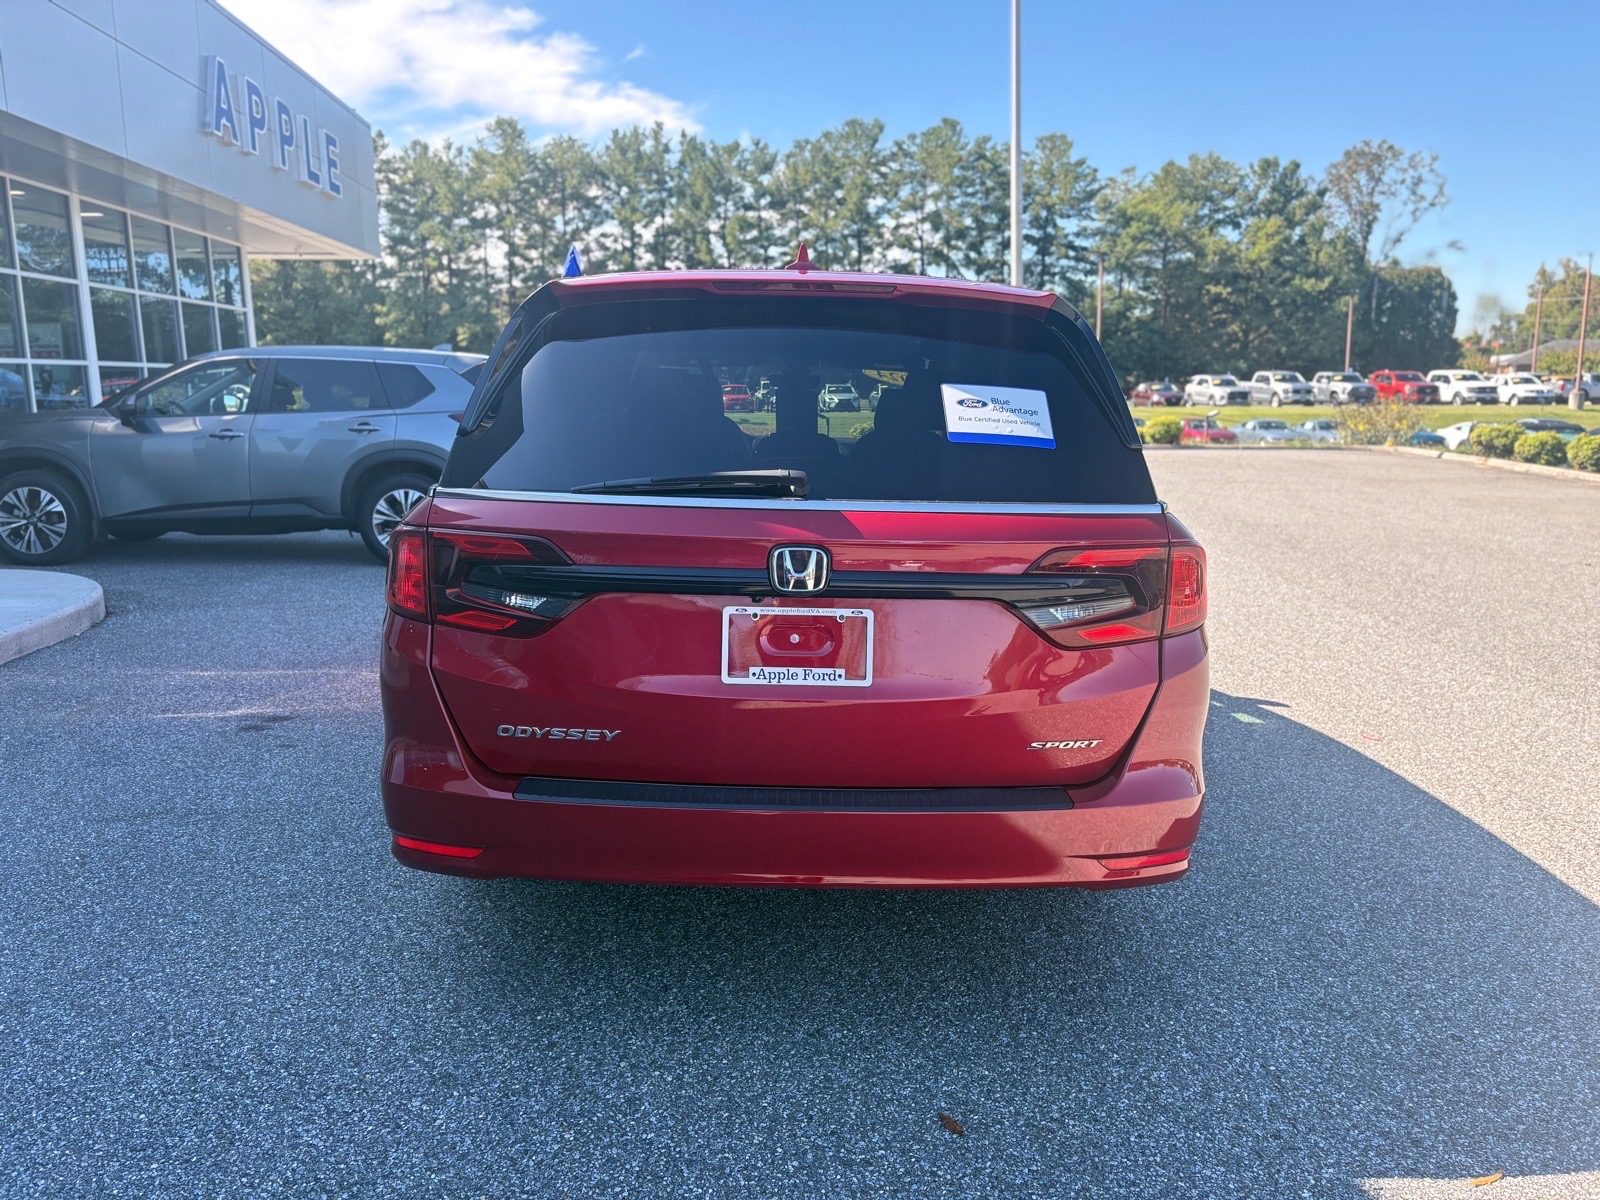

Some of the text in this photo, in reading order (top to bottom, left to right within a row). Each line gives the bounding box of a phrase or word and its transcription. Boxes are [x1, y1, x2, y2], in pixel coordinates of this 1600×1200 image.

[206, 56, 343, 199] APPLE
[991, 398, 1011, 406] Blue
[992, 405, 1039, 417] Advantage
[974, 416, 1000, 424] Certified
[1019, 419, 1041, 427] Vehicle
[756, 668, 838, 683] Apple Ford
[496, 724, 622, 742] ODYSSEY
[1026, 739, 1104, 750] SPORT
